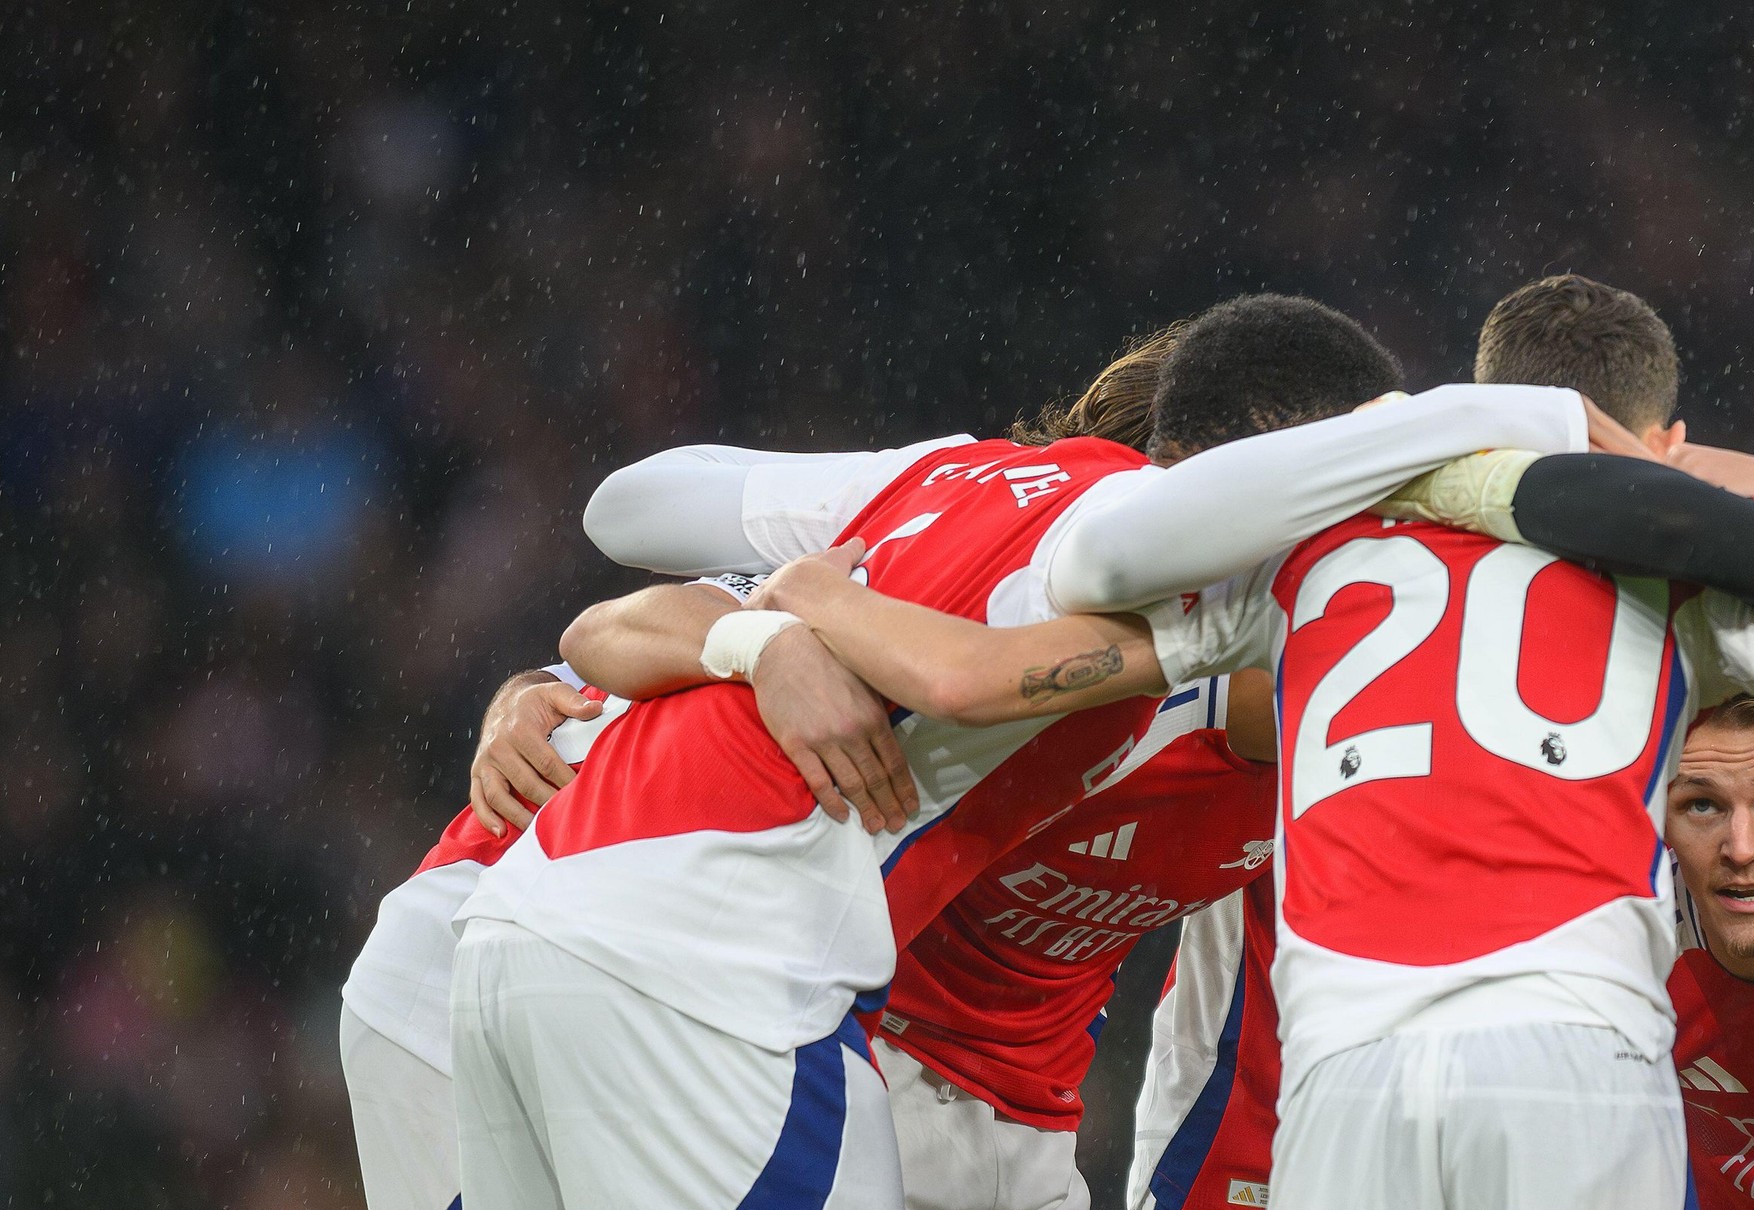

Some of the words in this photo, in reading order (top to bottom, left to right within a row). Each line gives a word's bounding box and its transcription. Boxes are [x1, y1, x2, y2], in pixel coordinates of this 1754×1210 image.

[1292, 535, 1670, 821] 20
[984, 908, 1068, 945] FLY
[999, 862, 1213, 928] Emirat
